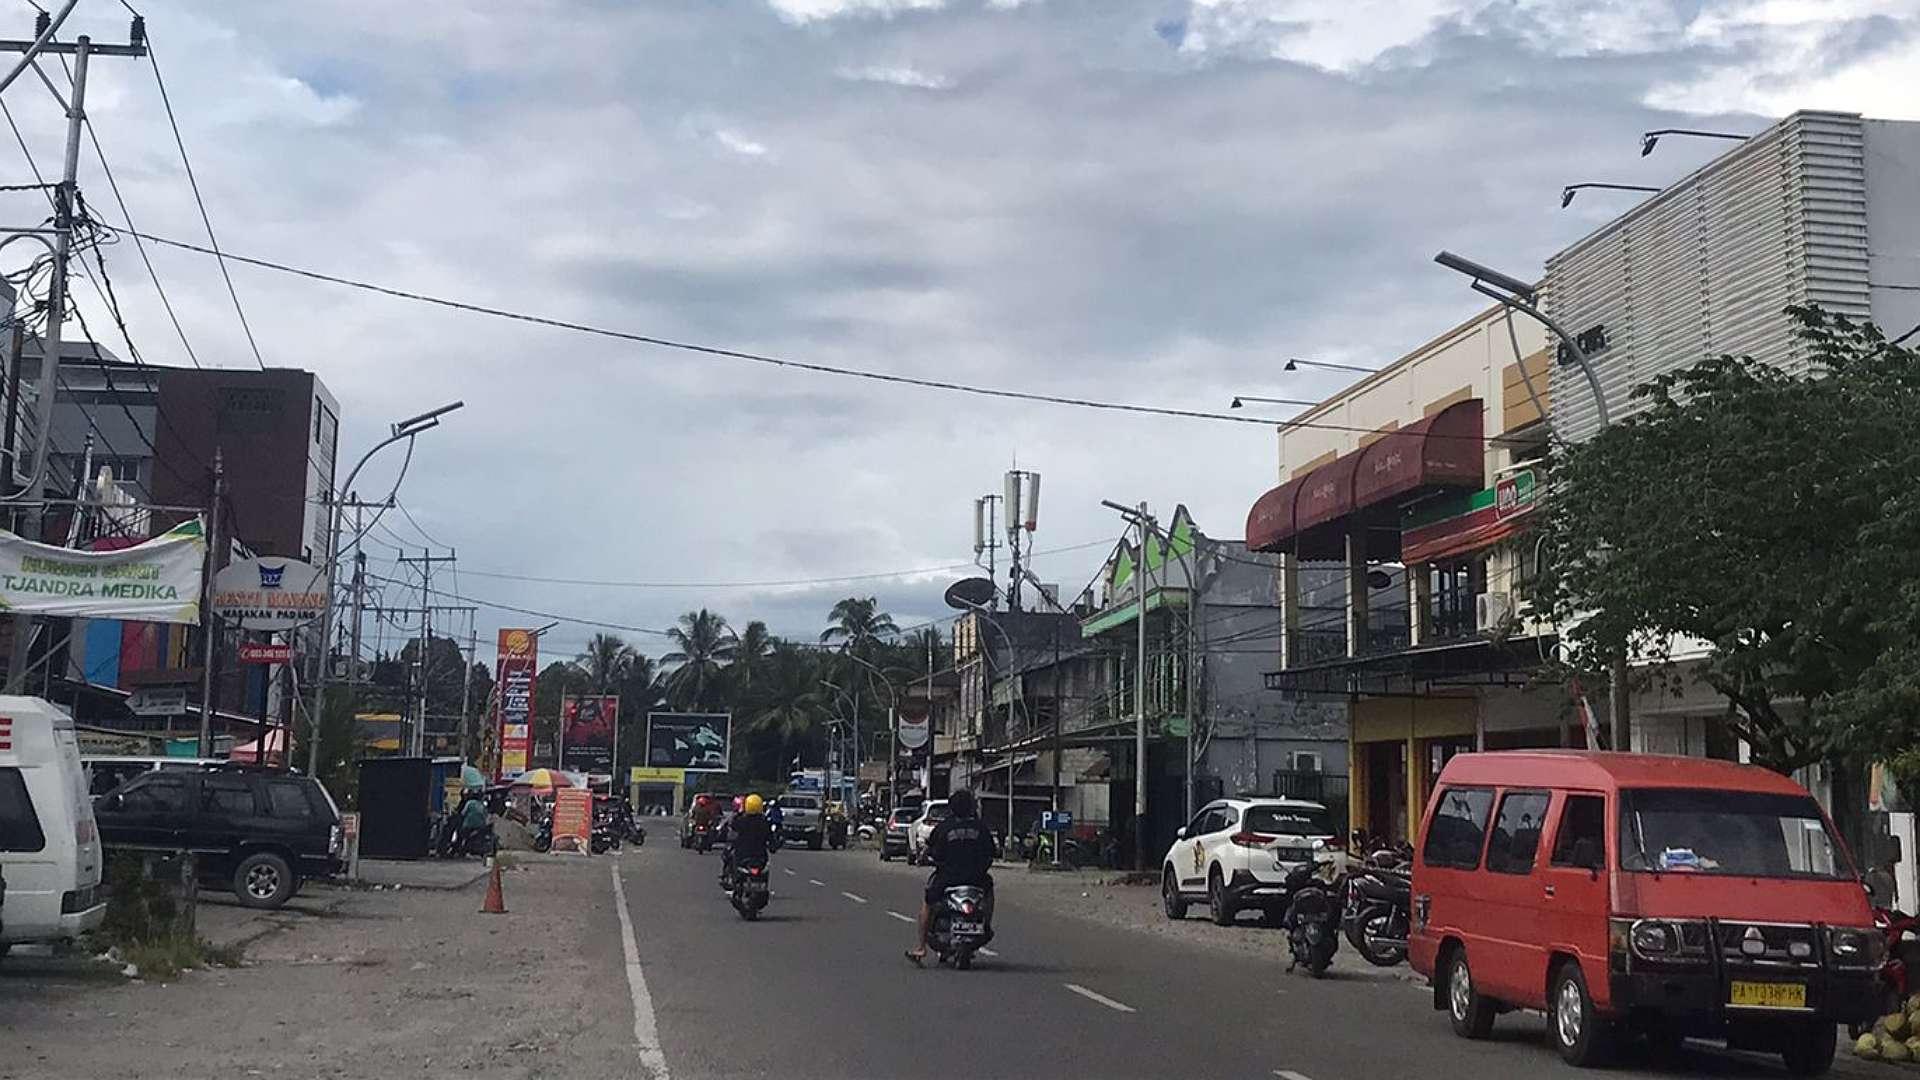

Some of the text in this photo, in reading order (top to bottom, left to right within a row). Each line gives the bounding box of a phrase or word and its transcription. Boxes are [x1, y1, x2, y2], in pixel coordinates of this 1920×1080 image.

[3, 575, 178, 600] TJANDRA MEDIKA
[222, 609, 316, 620] MASAKAN PADANG
[1042, 811, 1052, 829] P
